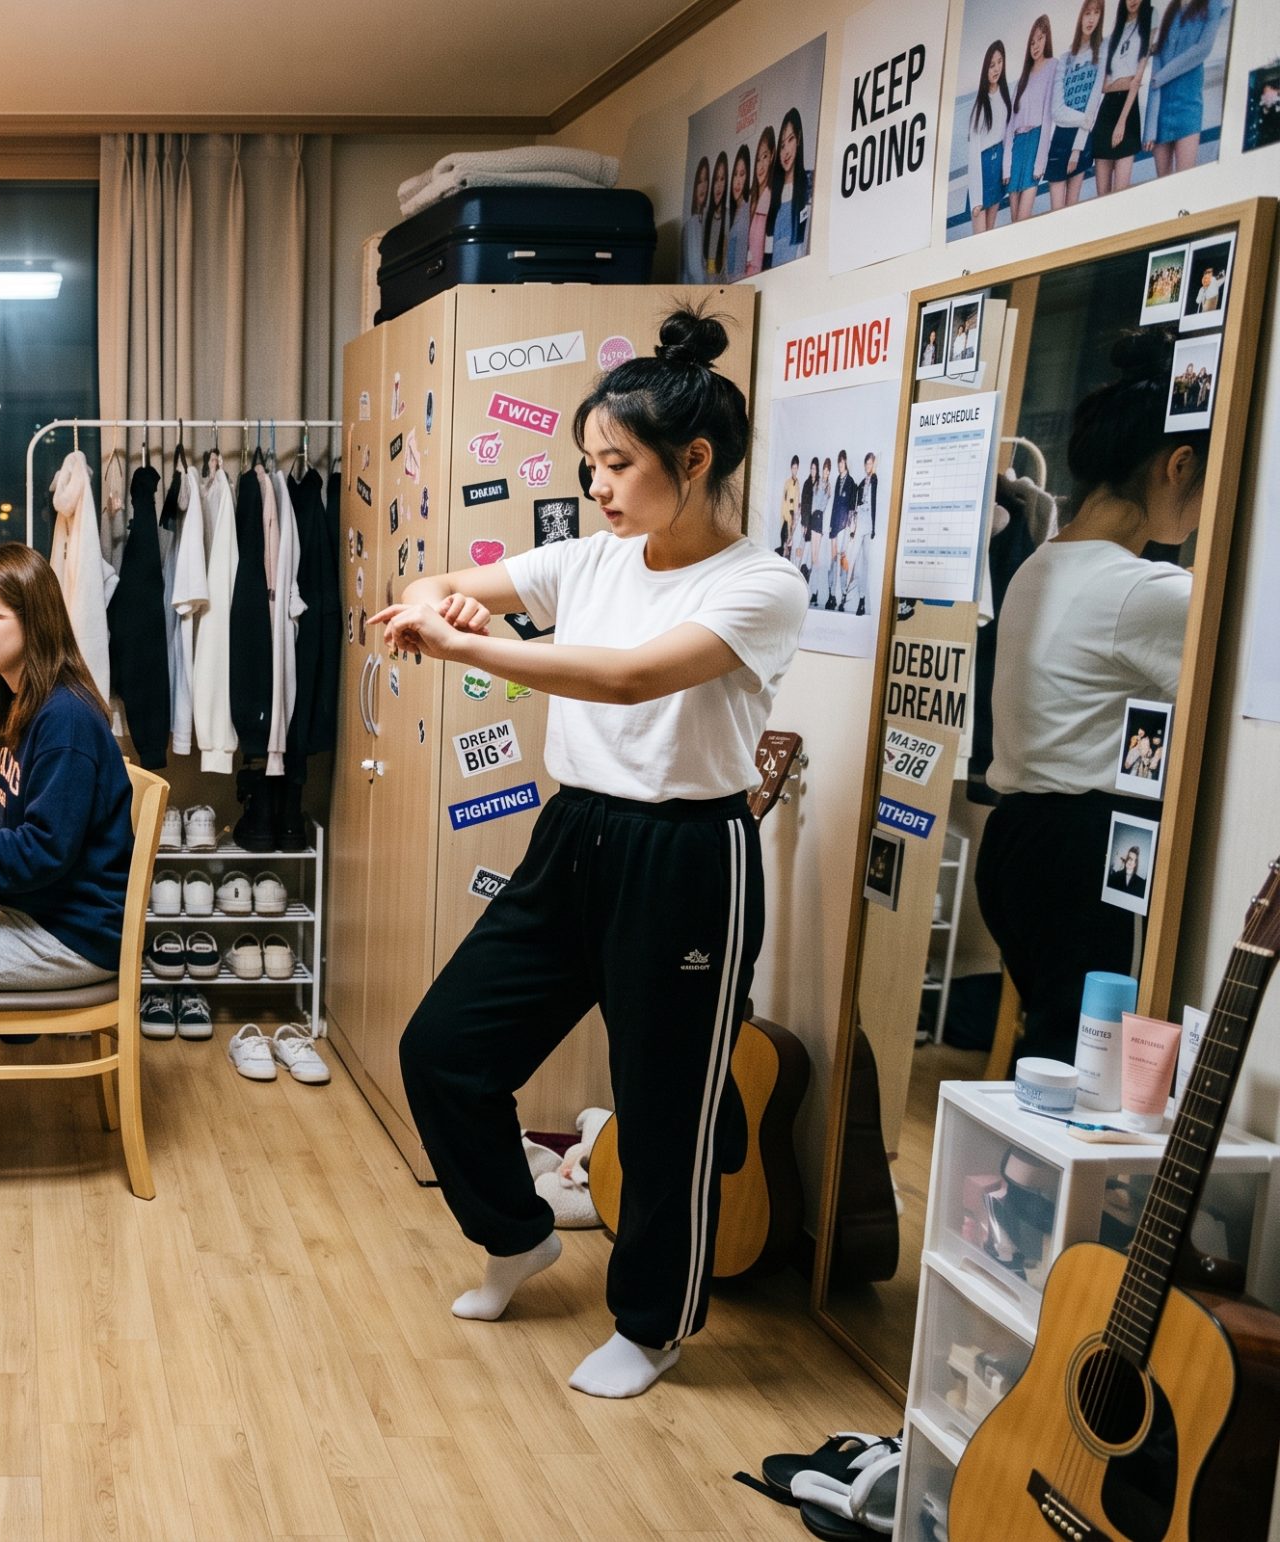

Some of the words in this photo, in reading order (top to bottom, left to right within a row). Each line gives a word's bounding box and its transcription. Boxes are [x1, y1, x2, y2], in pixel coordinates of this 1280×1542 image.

[850, 43, 926, 131] KEEP
[840, 112, 927, 199] GOING
[783, 317, 890, 381] FIGHTING!
[497, 399, 554, 429] TWICE
[920, 412, 941, 427] DAILY
[941, 407, 980, 425] SCHEDULE
[892, 641, 966, 683] DEBUT
[887, 682, 966, 729] DREAM
[459, 724, 510, 750] DREAM
[464, 744, 499, 772] BIG
[455, 788, 534, 823] FIGHTING!
